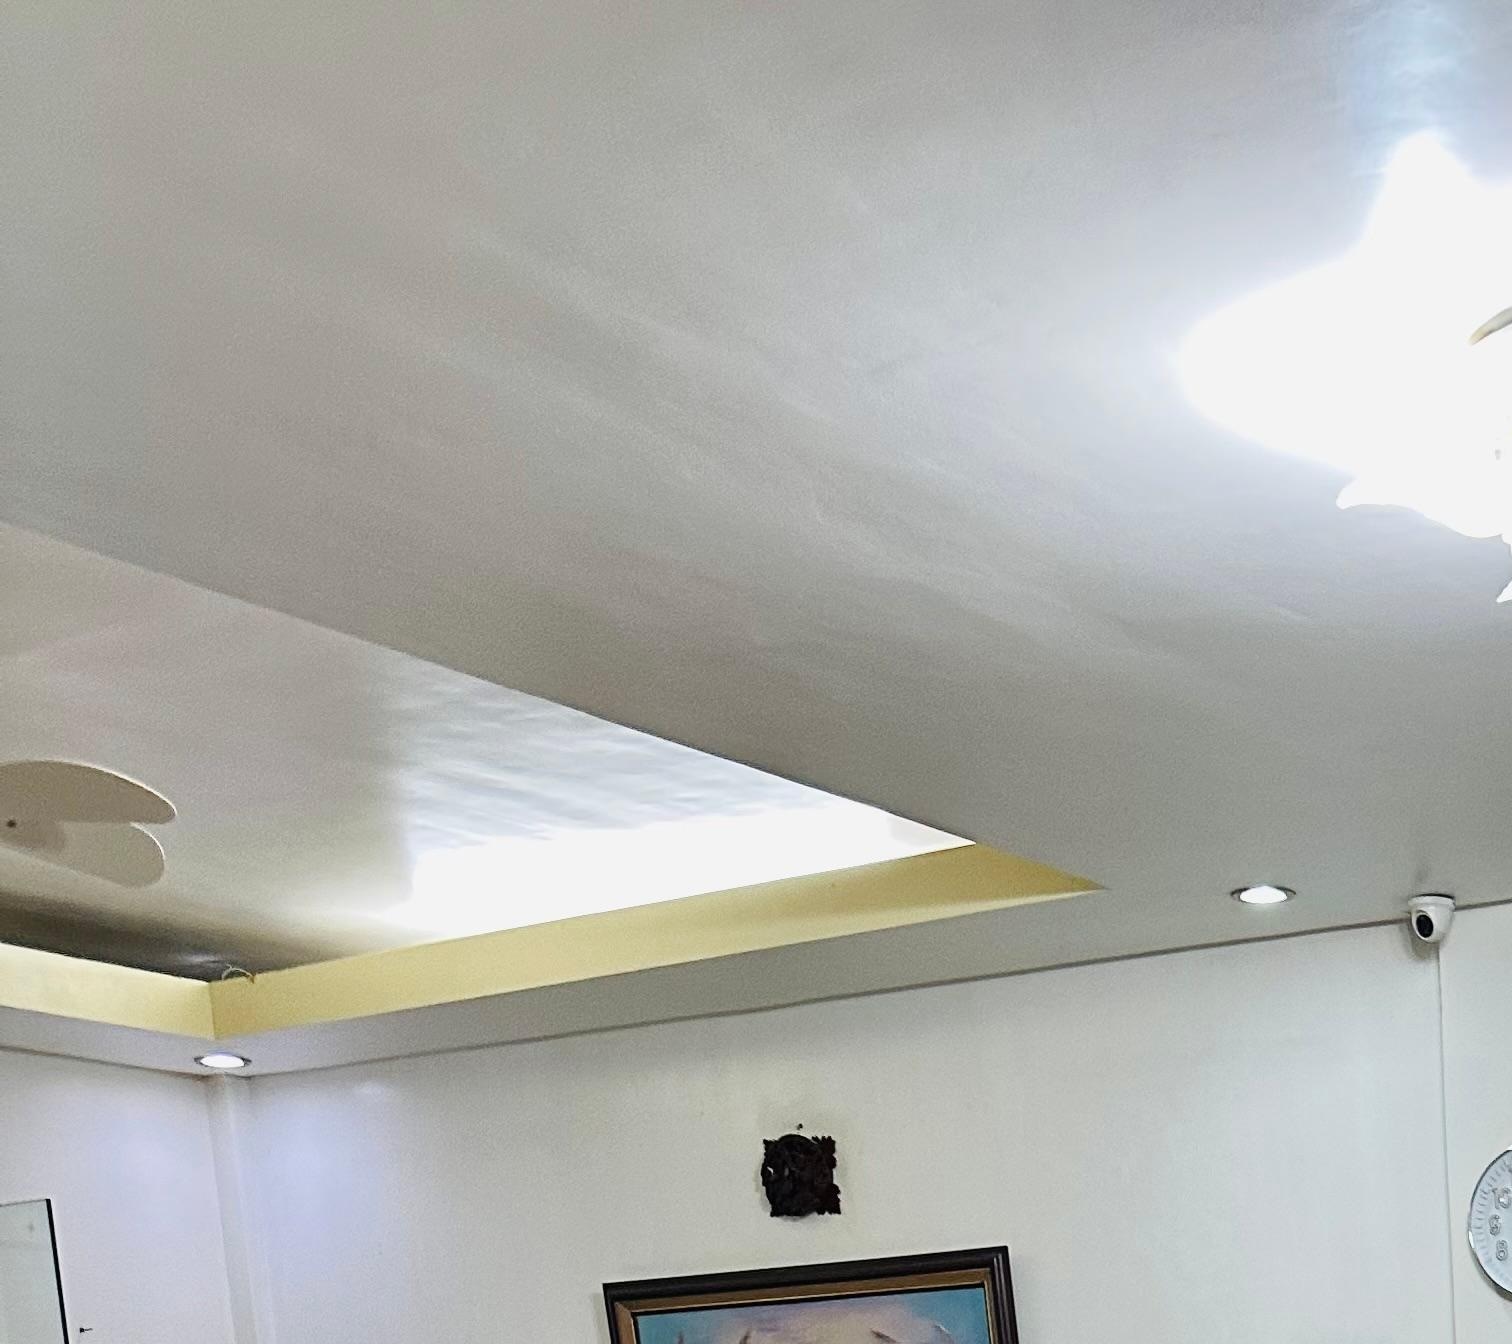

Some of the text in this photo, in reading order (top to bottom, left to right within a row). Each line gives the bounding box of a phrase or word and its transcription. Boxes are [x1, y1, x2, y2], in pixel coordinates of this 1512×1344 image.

[1491, 1187, 1512, 1210] 10
[1488, 1214, 1501, 1236] 9
[1495, 1239, 1508, 1261] 8
